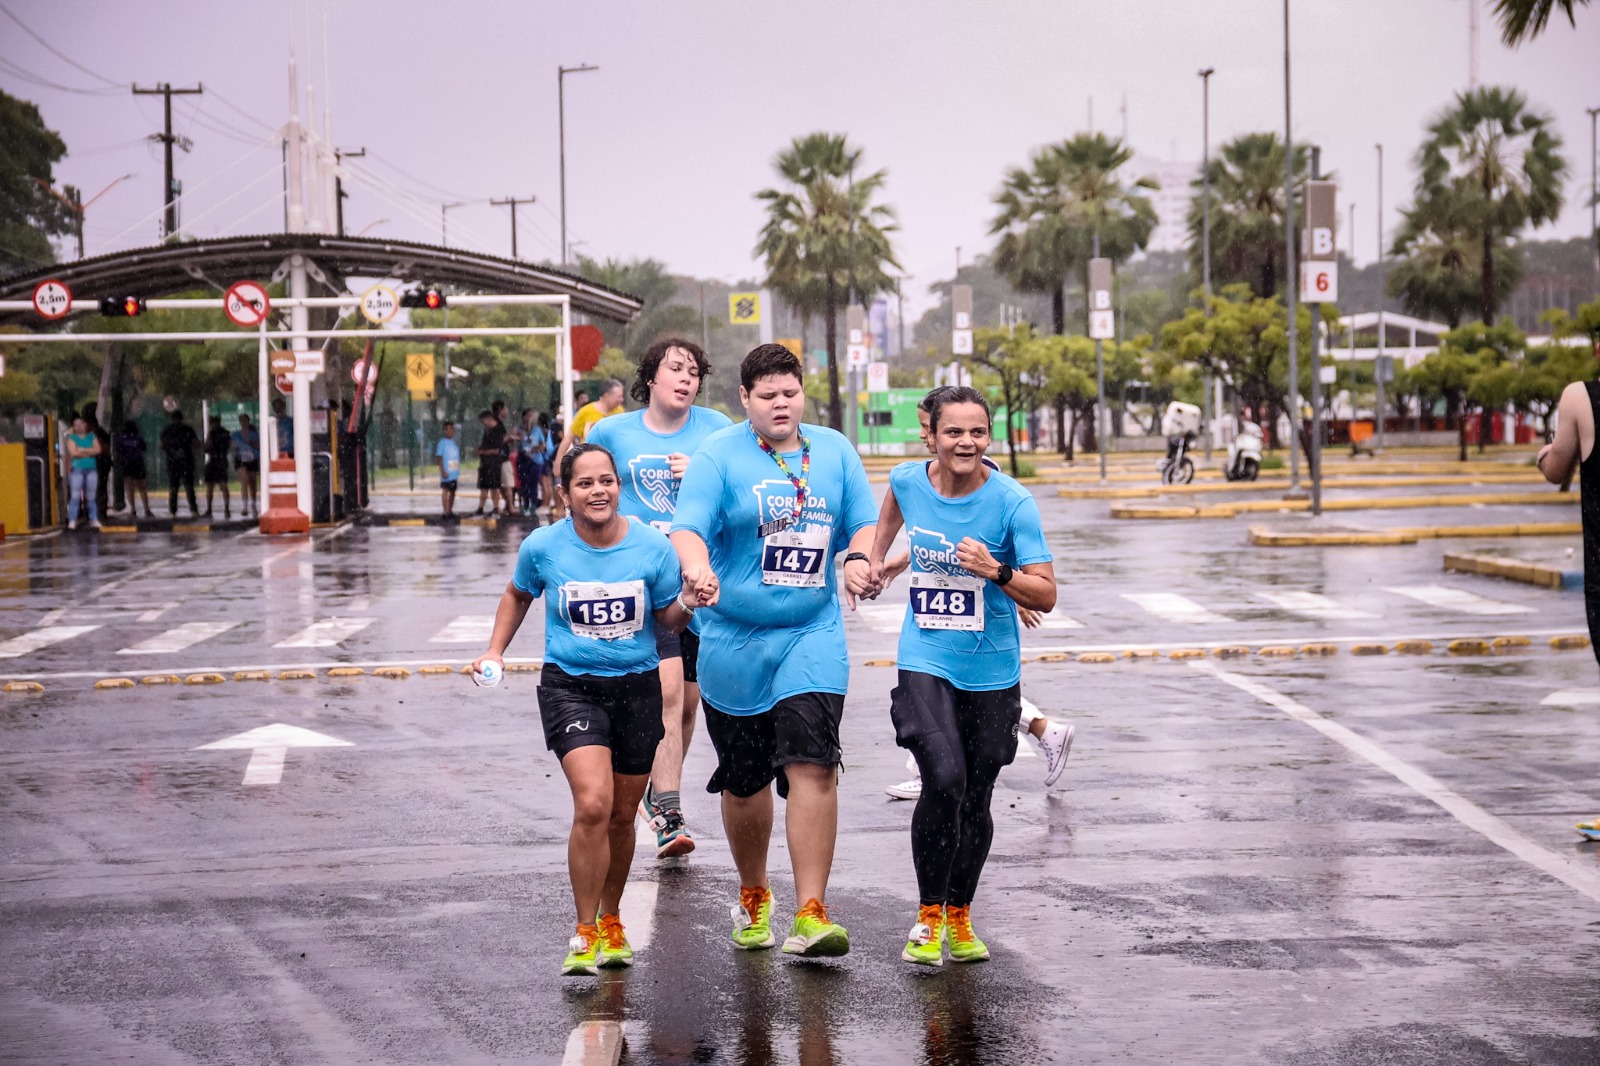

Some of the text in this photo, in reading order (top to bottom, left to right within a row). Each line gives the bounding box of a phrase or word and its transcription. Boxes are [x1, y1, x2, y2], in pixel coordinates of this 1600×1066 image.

[1313, 227, 1333, 254] B
[1316, 272, 1328, 292] 6
[1095, 290, 1110, 309] B
[639, 468, 674, 480] CORRI
[801, 510, 834, 523] FAMÍLIA
[774, 549, 818, 572] 147
[578, 600, 626, 624] 158
[917, 591, 966, 614] 148
